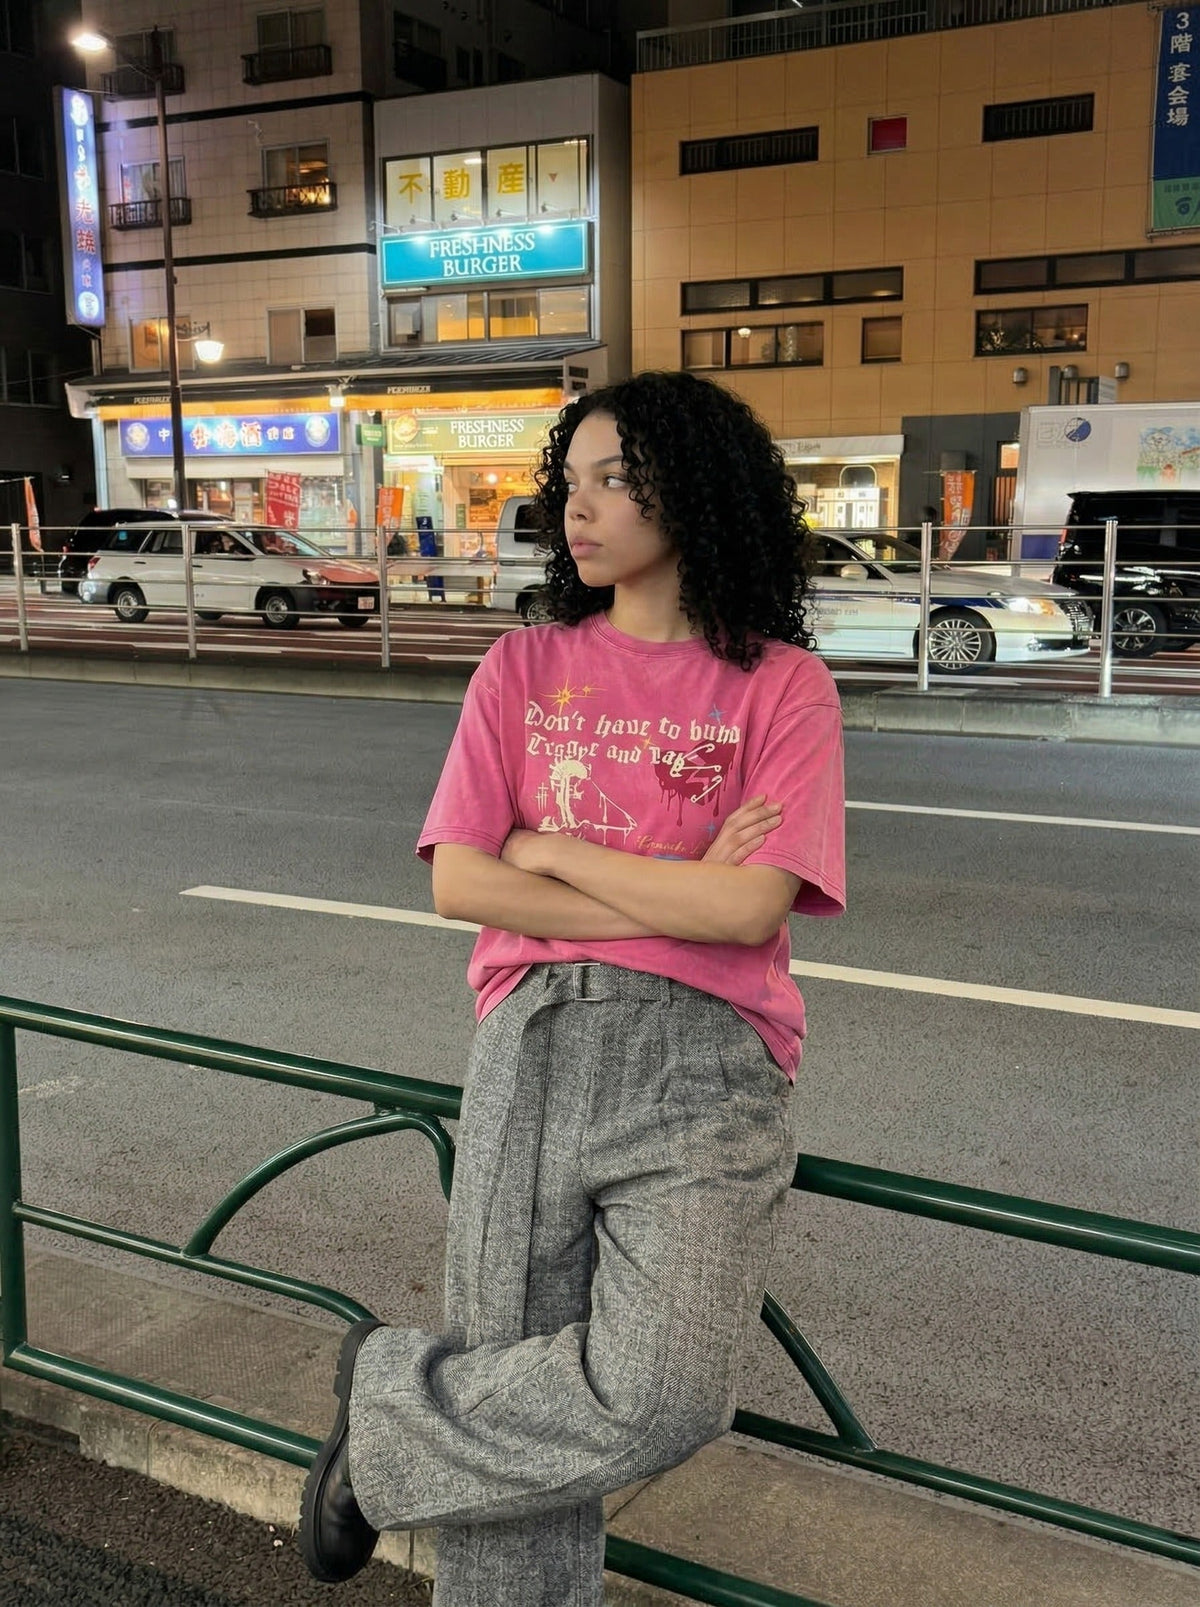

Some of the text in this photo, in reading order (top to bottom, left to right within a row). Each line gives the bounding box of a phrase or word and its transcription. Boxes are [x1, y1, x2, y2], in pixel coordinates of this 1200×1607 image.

[398, 162, 525, 204] 不動産
[429, 232, 536, 258] FRESHNESS
[443, 254, 522, 277] BURGER
[450, 418, 525, 435] FRESHNESS
[458, 433, 515, 449] BURGER
[594, 714, 651, 738] have
[658, 717, 681, 740] to
[607, 745, 642, 764] and
